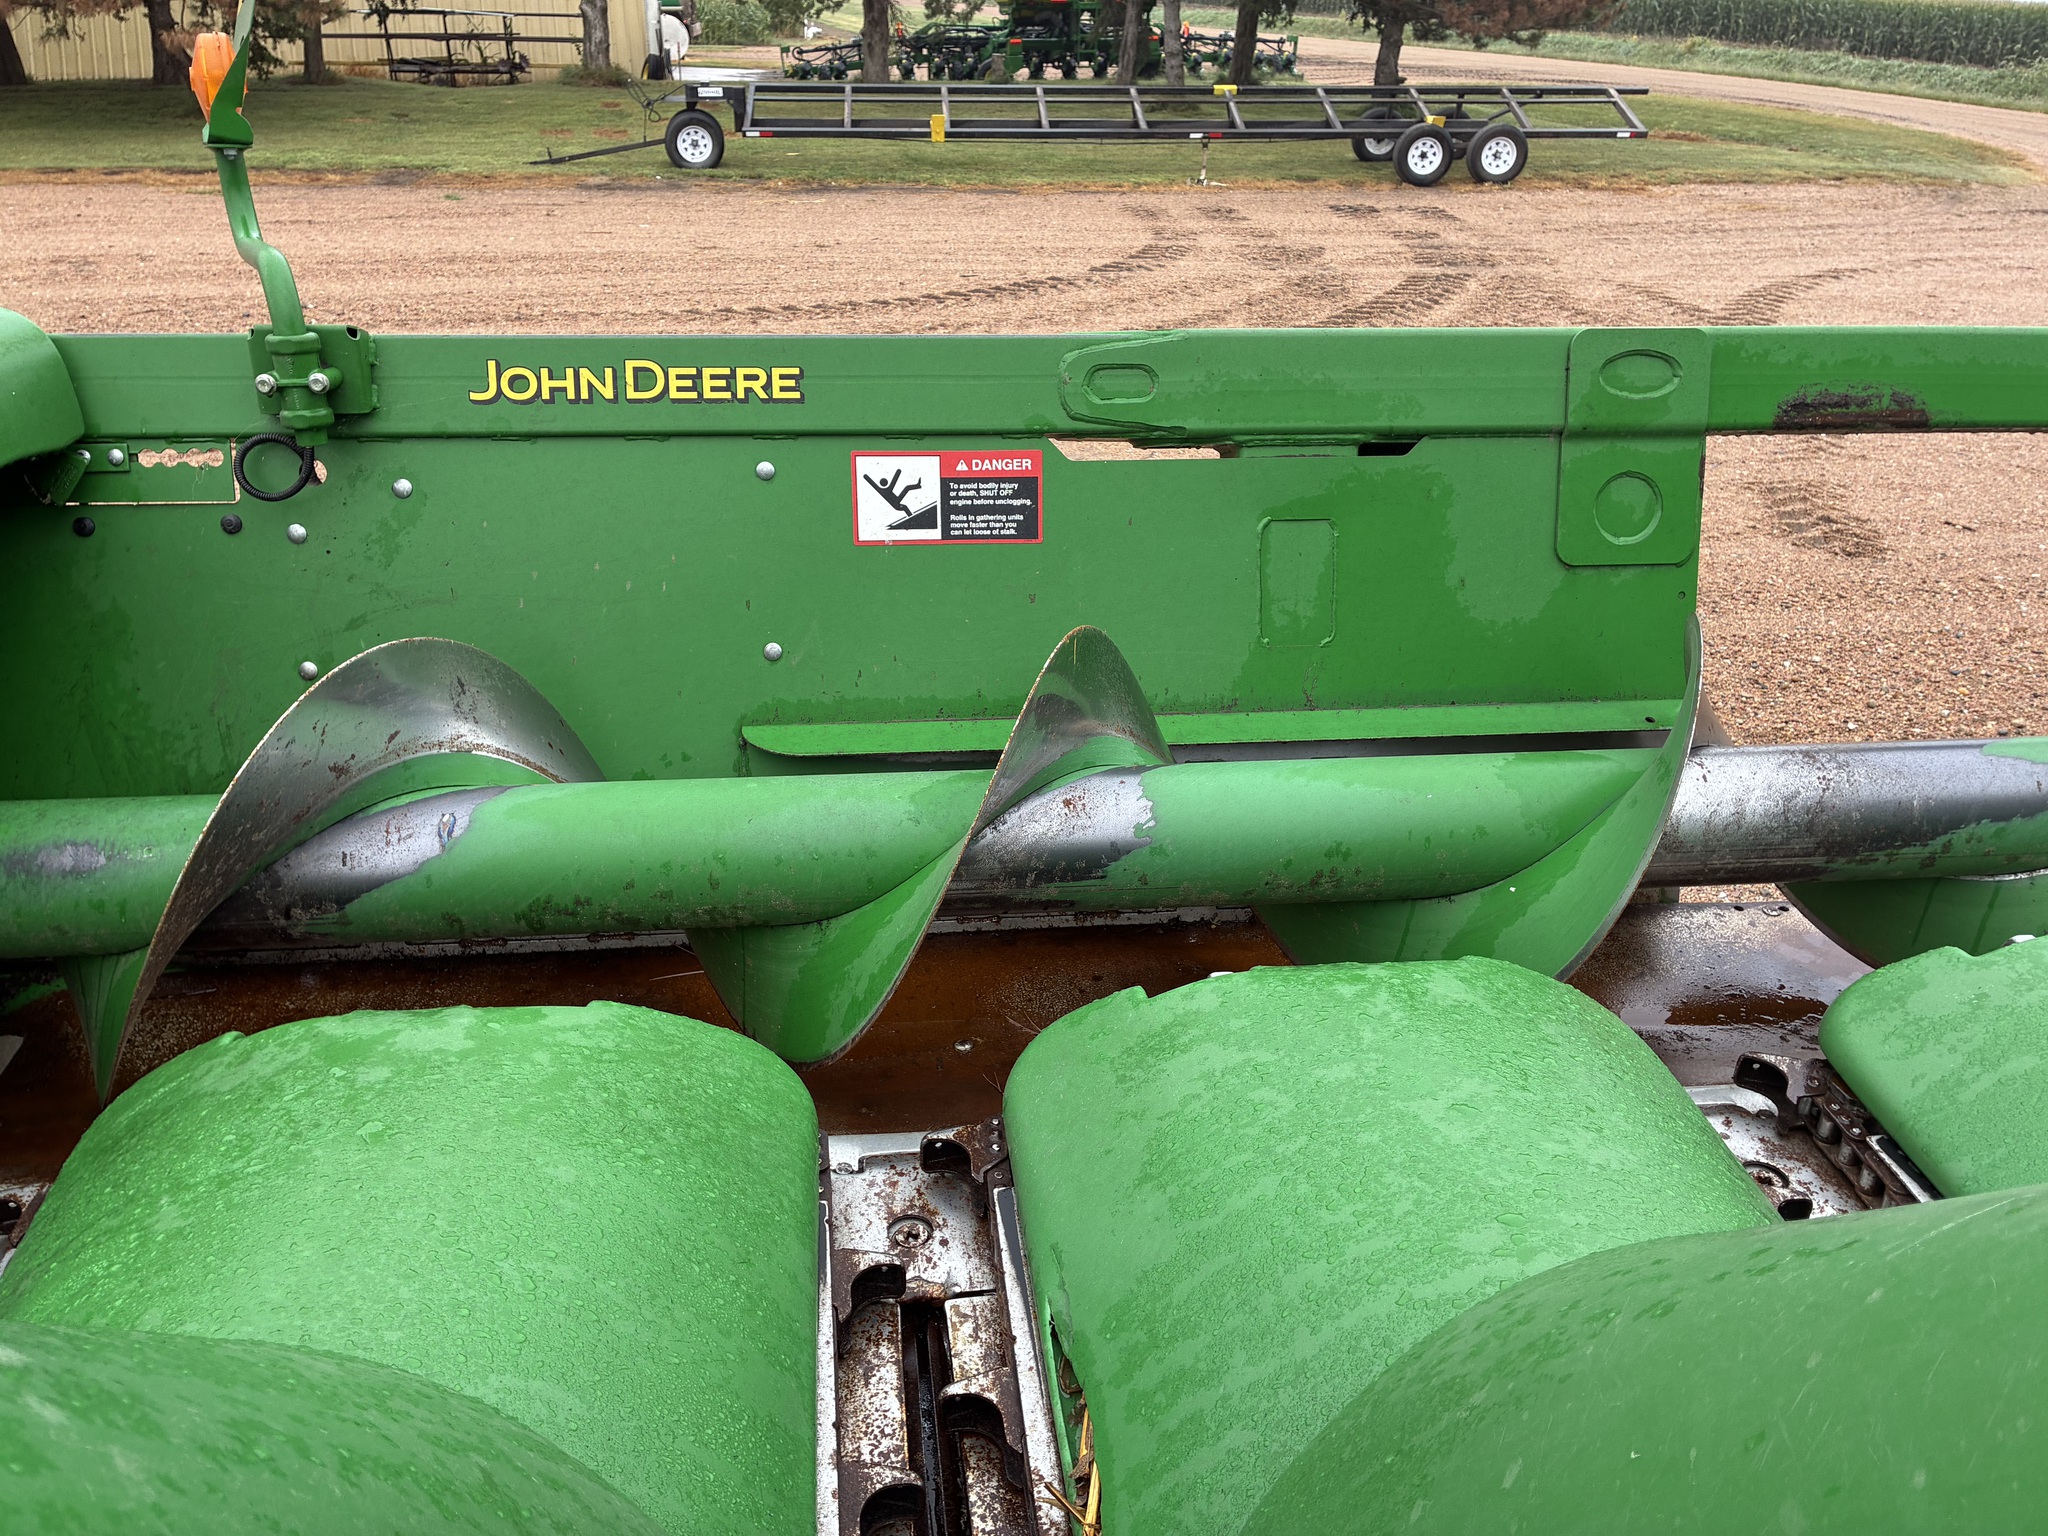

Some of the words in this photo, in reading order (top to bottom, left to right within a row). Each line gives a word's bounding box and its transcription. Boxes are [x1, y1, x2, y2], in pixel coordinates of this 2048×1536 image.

[468, 359, 618, 404] JOHN
[624, 358, 805, 404] DEERE
[972, 459, 1032, 470] DANGER
[979, 482, 998, 490] bodily
[1000, 482, 1018, 490] injury
[995, 498, 1032, 506] unclogging.
[976, 514, 1006, 522] gathering
